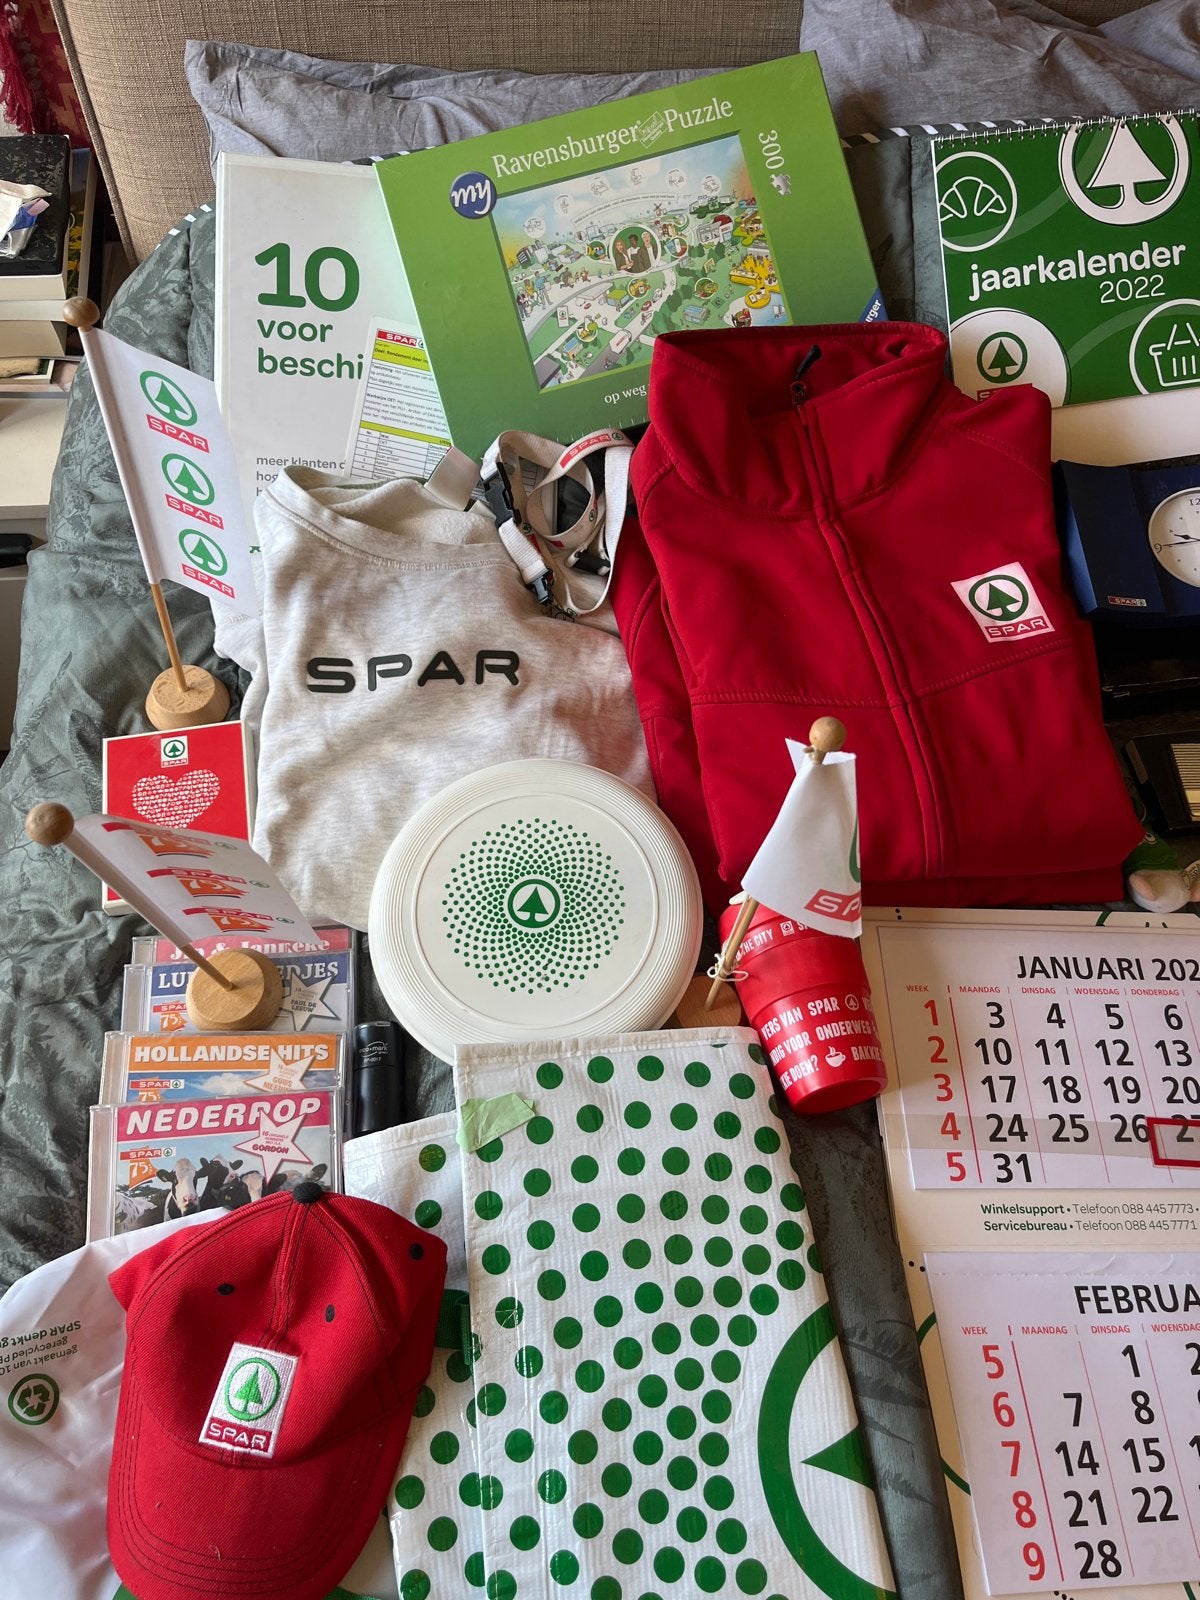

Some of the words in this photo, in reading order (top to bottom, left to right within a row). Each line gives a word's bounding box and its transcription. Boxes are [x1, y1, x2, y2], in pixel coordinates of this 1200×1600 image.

[663, 97, 734, 133] Puzzle
[758, 129, 786, 171] 300
[451, 179, 491, 214] my
[255, 242, 360, 312] 10
[969, 241, 1186, 301] jaarkalender
[1100, 274, 1165, 303] 2022
[257, 319, 333, 342] voor
[386, 333, 417, 346] SPAR
[258, 347, 364, 380] beschi
[604, 393, 620, 404] op
[622, 384, 647, 398] weg
[150, 417, 208, 452] SPAR
[569, 433, 612, 458] SPAR
[256, 457, 289, 466] meer
[291, 456, 337, 469] klanten
[168, 496, 223, 529] SPAR
[184, 565, 235, 597] SPAR
[1114, 597, 1137, 605] SPAR
[988, 618, 1046, 636] SPAR
[307, 650, 520, 694] SPAR
[171, 869, 247, 884] SPAR
[204, 908, 273, 920] SPAR
[754, 928, 774, 946] CITY
[1017, 955, 1144, 981] JANUARI
[1152, 958, 1200, 982] 202
[959, 986, 1001, 994] MAANDAG
[1074, 987, 1120, 995] WOENSDAG
[1131, 988, 1180, 996] DONDERDAG
[161, 1014, 179, 1029] 75
[761, 1017, 781, 1040] VERS
[779, 1007, 803, 1027] VAN
[807, 997, 840, 1016] SPAR
[924, 1000, 939, 1026] 1
[986, 1002, 1005, 1028] 3
[1046, 1003, 1066, 1029] 4
[1105, 1004, 1124, 1030] 5
[1164, 1004, 1183, 1030] 6
[783, 1031, 812, 1054] VOOR
[815, 1020, 871, 1041] ONDERWEG
[134, 1043, 272, 1063] HOLLANDSE
[277, 1044, 329, 1061] HITS
[927, 1036, 948, 1064] 2
[975, 1038, 1012, 1066] 10
[1035, 1038, 1070, 1066] 11
[1095, 1039, 1134, 1066] 12
[1155, 1039, 1193, 1067] 13
[790, 1054, 819, 1082] DOEN?
[933, 1073, 953, 1102] 3
[981, 1075, 1016, 1103] 17
[1042, 1075, 1082, 1104] 18
[1103, 1076, 1141, 1104] 19
[1161, 1076, 1200, 1104] 20
[126, 1097, 321, 1135] NEDERPOP
[940, 1112, 961, 1141] 4
[986, 1113, 1028, 1143] 24
[1048, 1113, 1089, 1143] 25
[1110, 1113, 1150, 1143] 26
[129, 1149, 162, 1158] SPAR
[252, 1143, 289, 1154] GORDON
[129, 1161, 149, 1178] 75
[947, 1152, 966, 1182] 5
[993, 1153, 1032, 1183] 31
[981, 1203, 1065, 1216] Winkelsupport
[1072, 1203, 1121, 1214] Telefoon
[1122, 1203, 1144, 1214] 088
[1146, 1203, 1167, 1214] 445
[1167, 1203, 1194, 1214] 7773
[984, 1220, 1067, 1231] Servicebureau
[1074, 1220, 1124, 1231] Telefoon
[1125, 1220, 1147, 1231] 088
[1149, 1220, 1170, 1231] 445
[1170, 1220, 1198, 1231] 7771
[1074, 1283, 1200, 1315] FEBRUA
[11, 1329, 47, 1346] denkt
[49, 1320, 81, 1336] SPAR
[962, 1326, 988, 1335] WEEK
[1022, 1325, 1068, 1335] MAANDAG
[1091, 1325, 1131, 1334] DINSDAG
[1151, 1323, 1200, 1333] WOENSDAG
[12, 1335, 68, 1360] gerecycled
[34, 1344, 78, 1365] gemaakt
[14, 1359, 32, 1370] van
[982, 1344, 1004, 1379] 5
[1122, 1344, 1140, 1378] 1
[993, 1391, 1015, 1428] 6
[1063, 1392, 1082, 1427] 7
[1131, 1390, 1154, 1425] 8
[208, 1422, 267, 1449] SPAR
[1001, 1441, 1021, 1477] 7
[1055, 1440, 1100, 1476] 14
[1122, 1437, 1165, 1473] 15
[1012, 1490, 1037, 1529] 8
[1064, 1489, 1108, 1527] 21
[1131, 1485, 1179, 1523] 22
[1023, 1541, 1046, 1581] 9
[1074, 1539, 1122, 1580] 28
